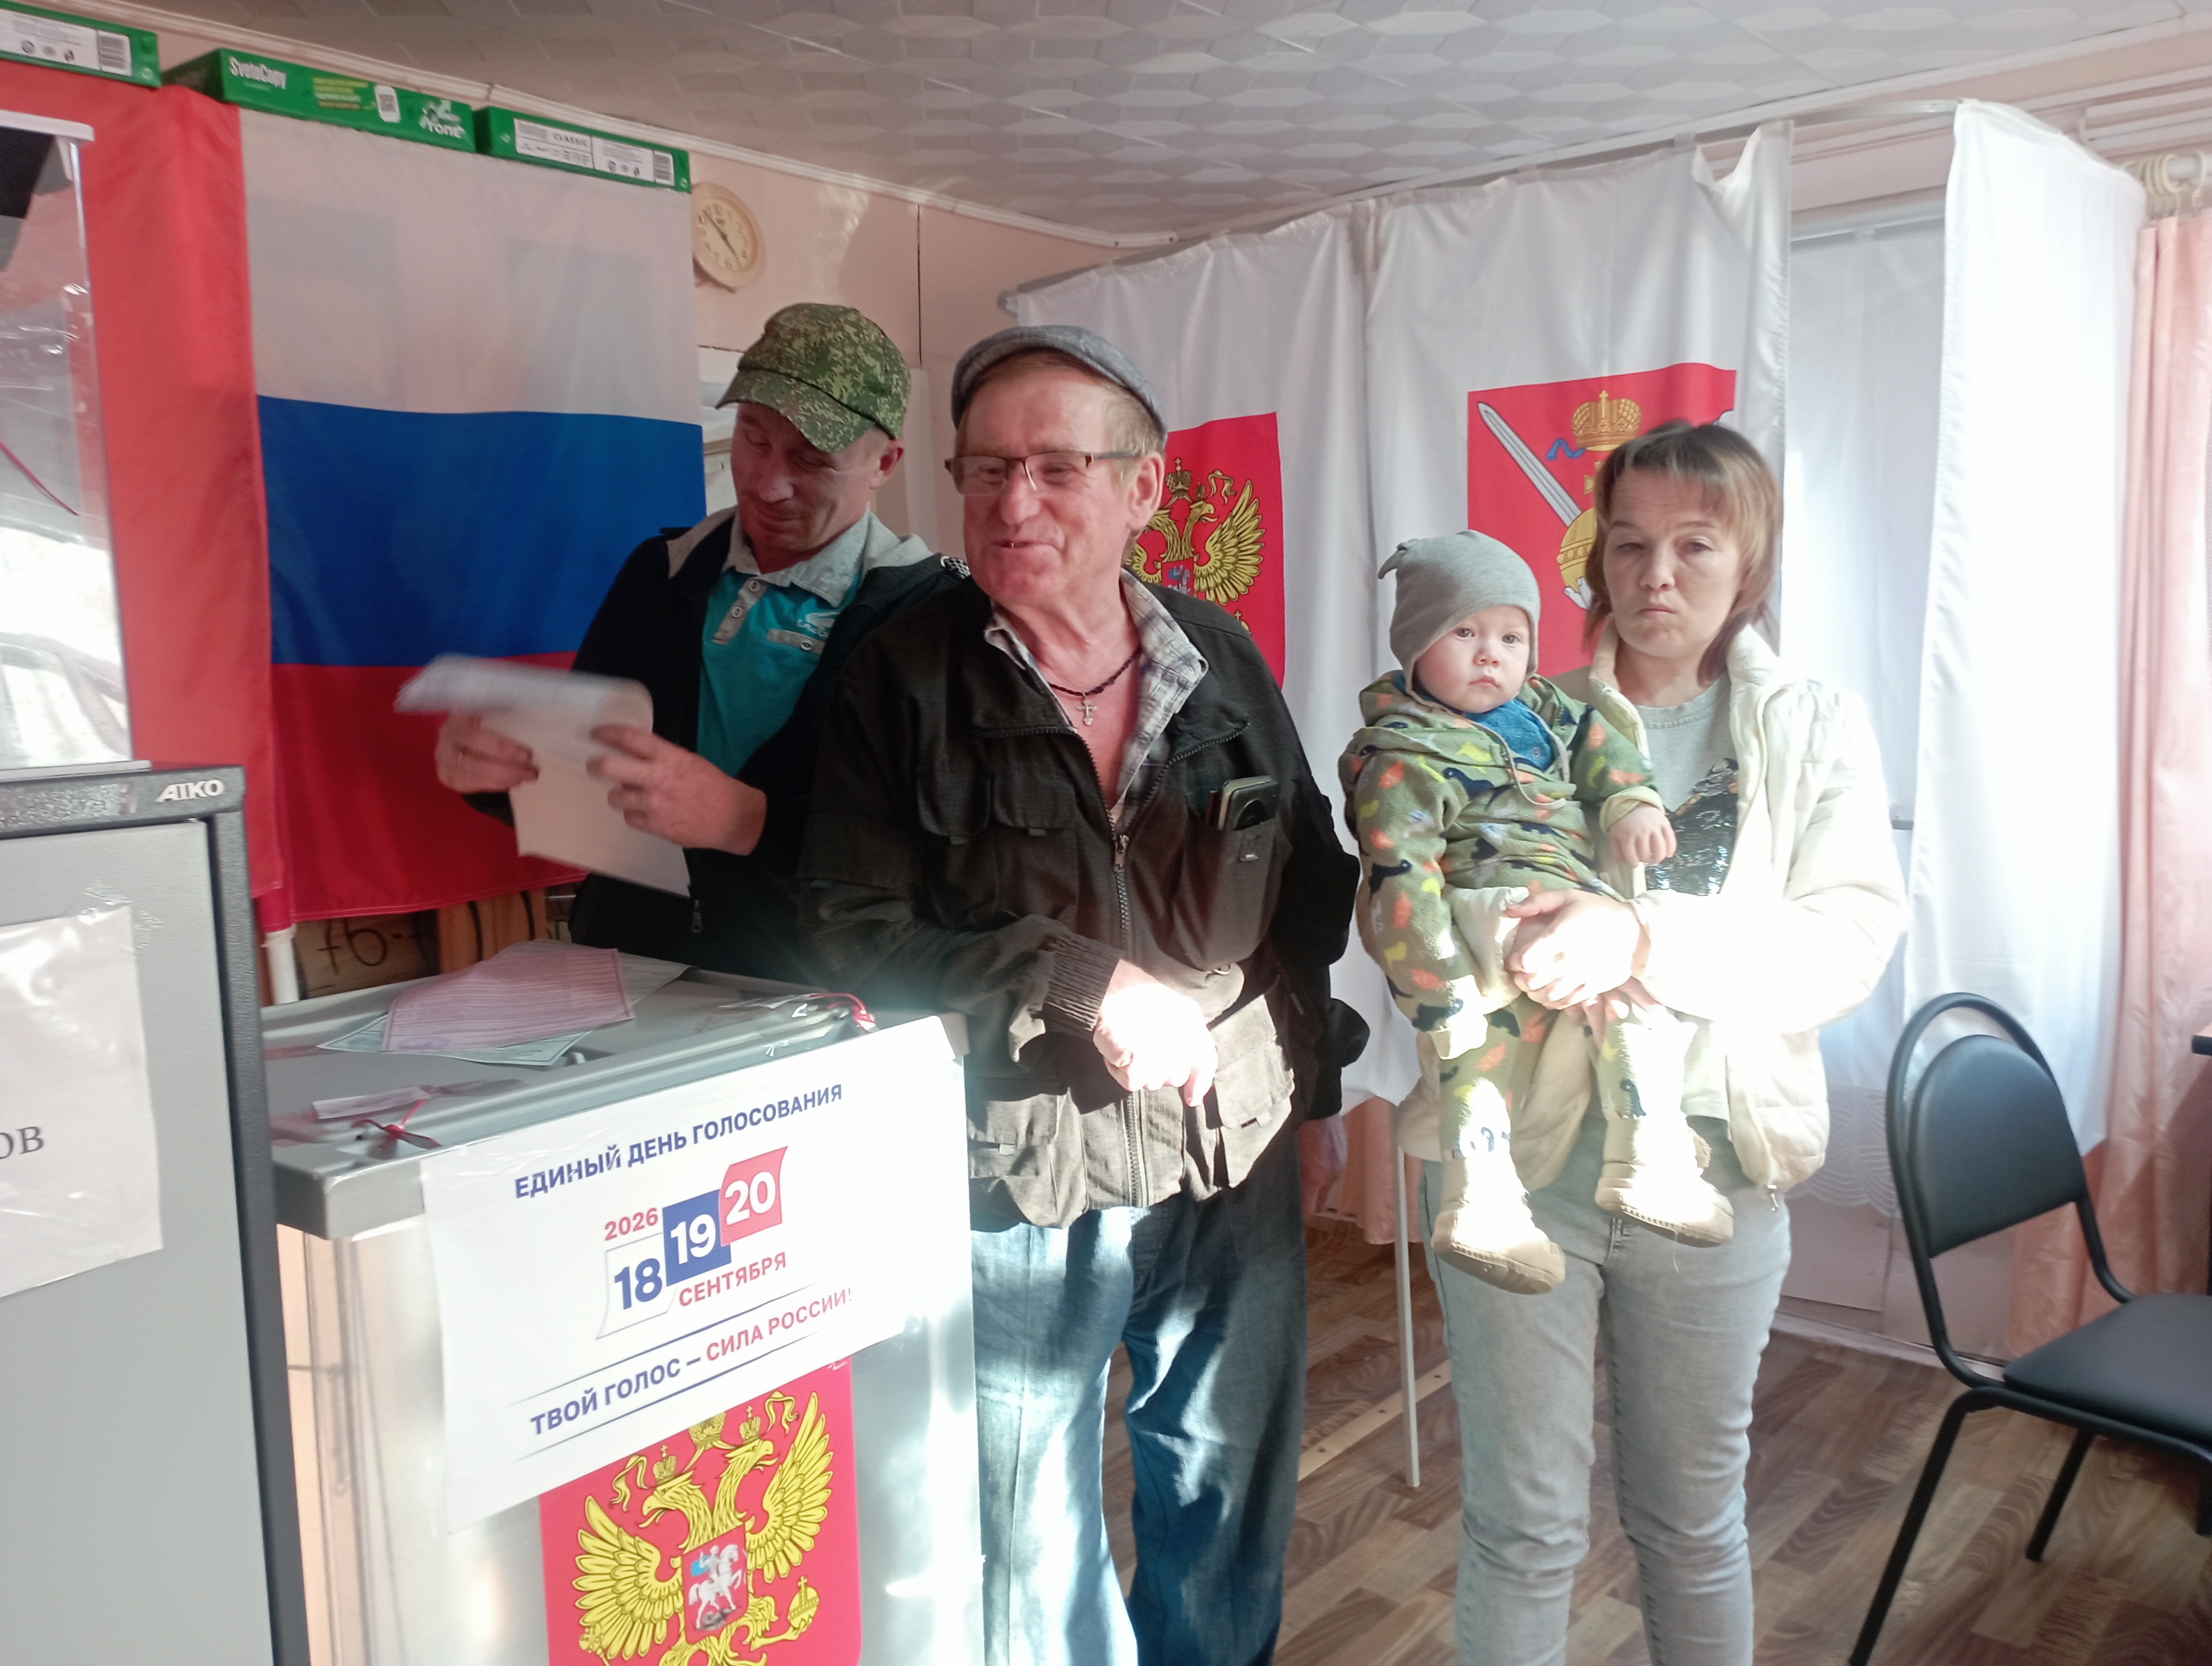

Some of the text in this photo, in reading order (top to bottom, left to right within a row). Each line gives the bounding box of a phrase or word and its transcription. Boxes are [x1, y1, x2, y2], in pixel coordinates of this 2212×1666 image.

[155, 779, 224, 803] AIKO
[515, 1084, 841, 1199] ЕДИНЫЙ ДЕНЬ ГОЛОСОВАНИЯ
[605, 1207, 658, 1241] 2026
[614, 1171, 776, 1310] 18 19 20
[679, 1252, 786, 1306] СЕНТЯБРЯ
[530, 1387, 597, 1435] ТВОЙ
[605, 1358, 681, 1406] ГОЛОС
[706, 1325, 763, 1361] СИЛА
[768, 1287, 851, 1335] РОССИИ!
